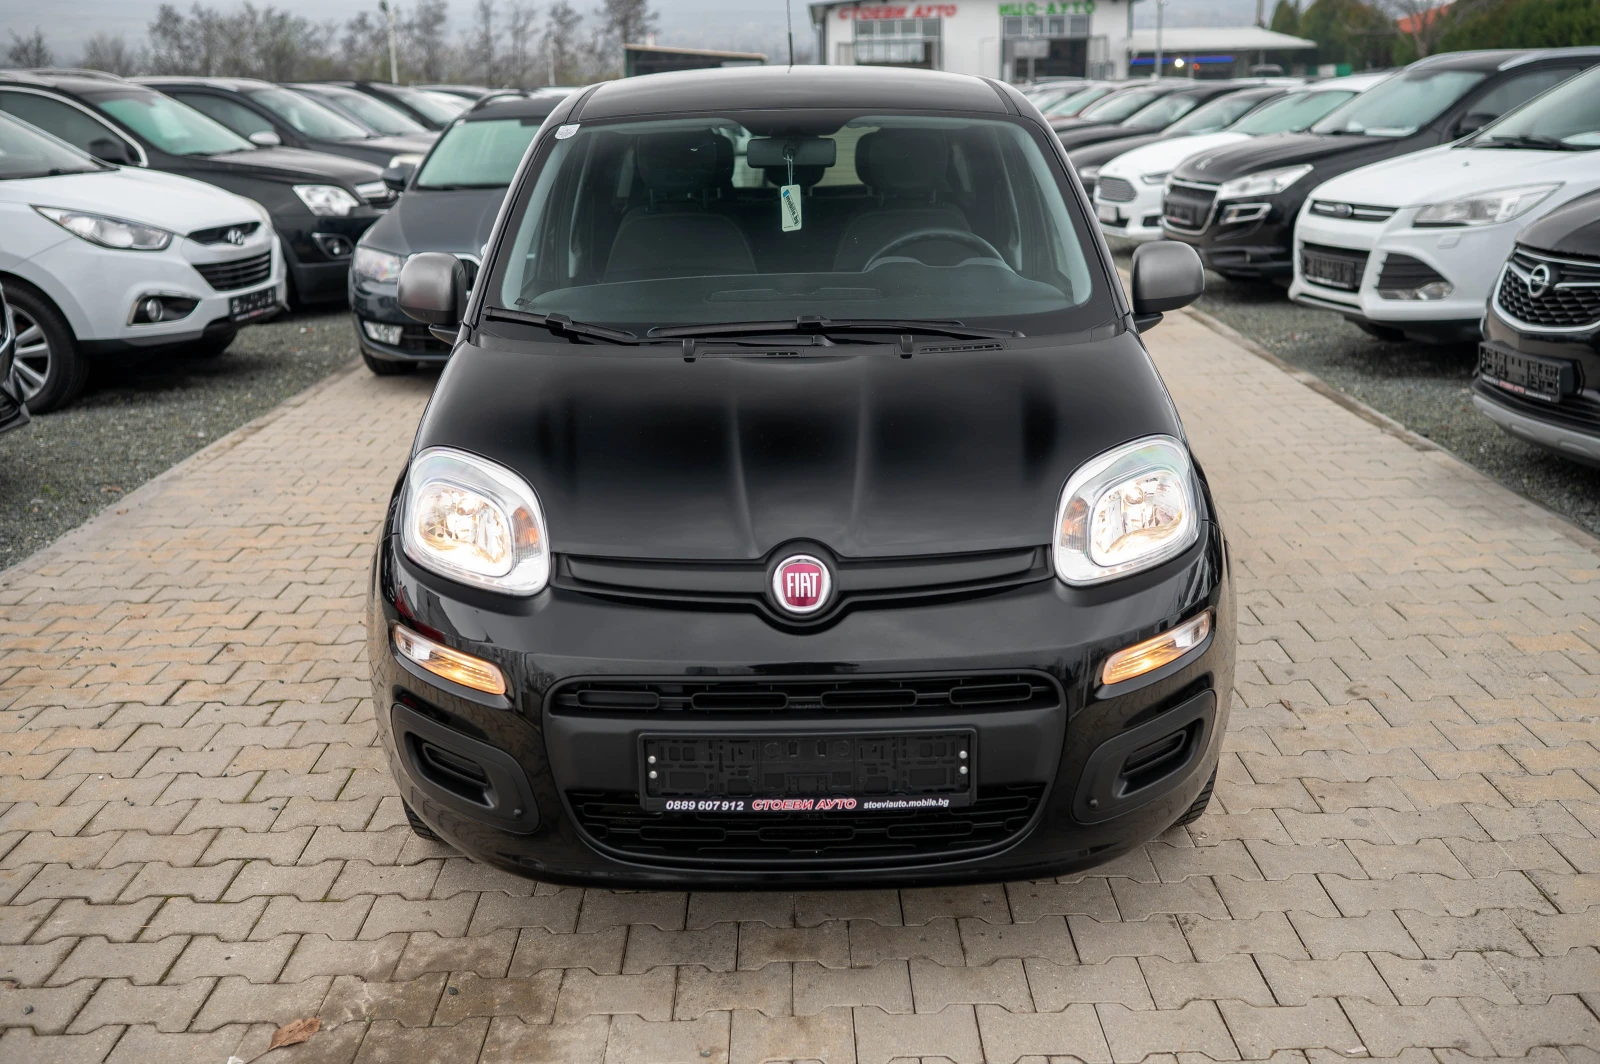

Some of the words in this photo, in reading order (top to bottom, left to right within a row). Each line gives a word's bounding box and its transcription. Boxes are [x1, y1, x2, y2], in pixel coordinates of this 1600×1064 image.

[913, 4, 958, 18] АУТО
[786, 572, 819, 598] FIAT
[666, 800, 696, 810] 0889
[698, 801, 720, 810] 607
[721, 801, 744, 810] 912
[752, 799, 814, 811] СТОЕВИ
[815, 798, 857, 810] АУТО
[863, 798, 949, 809] stoeviauto.mobile.bg
